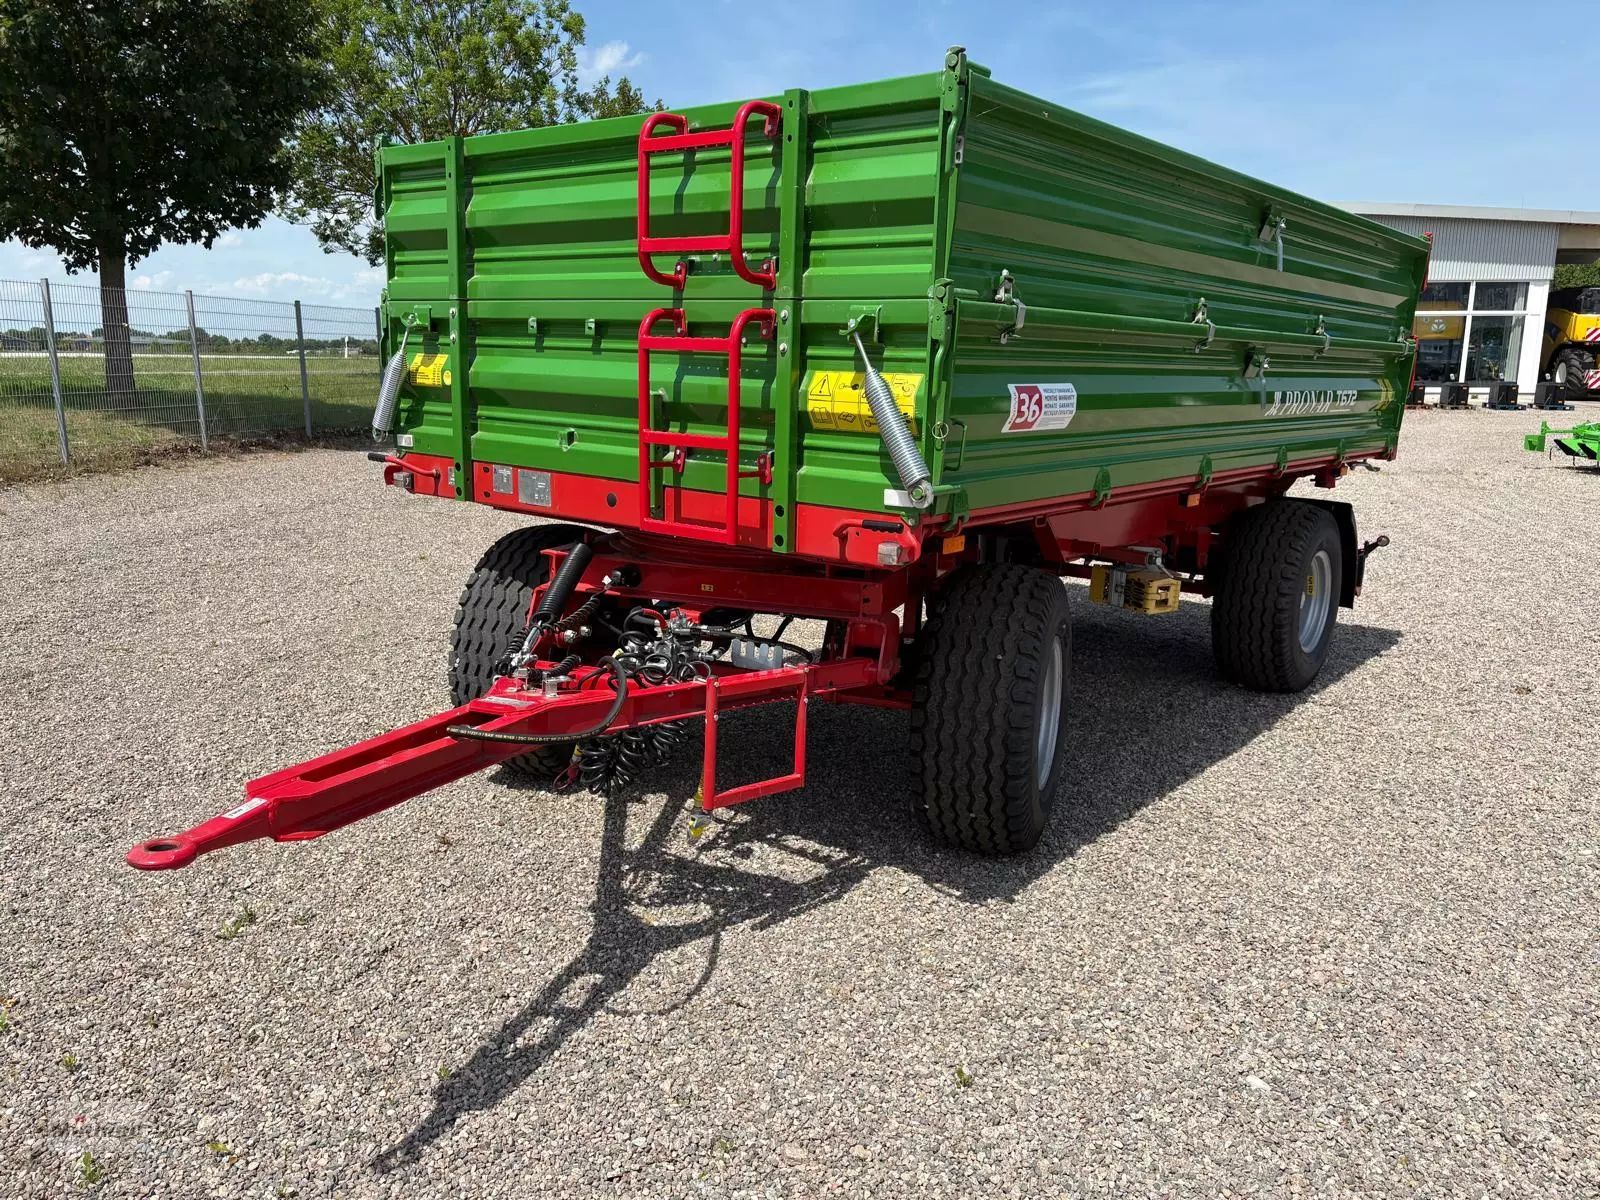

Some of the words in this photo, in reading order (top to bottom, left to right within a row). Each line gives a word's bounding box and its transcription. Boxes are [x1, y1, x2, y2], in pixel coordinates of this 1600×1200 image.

[1014, 393, 1040, 423] 36
[1278, 390, 1333, 416] PRONAR
[1335, 390, 1358, 407] T672
